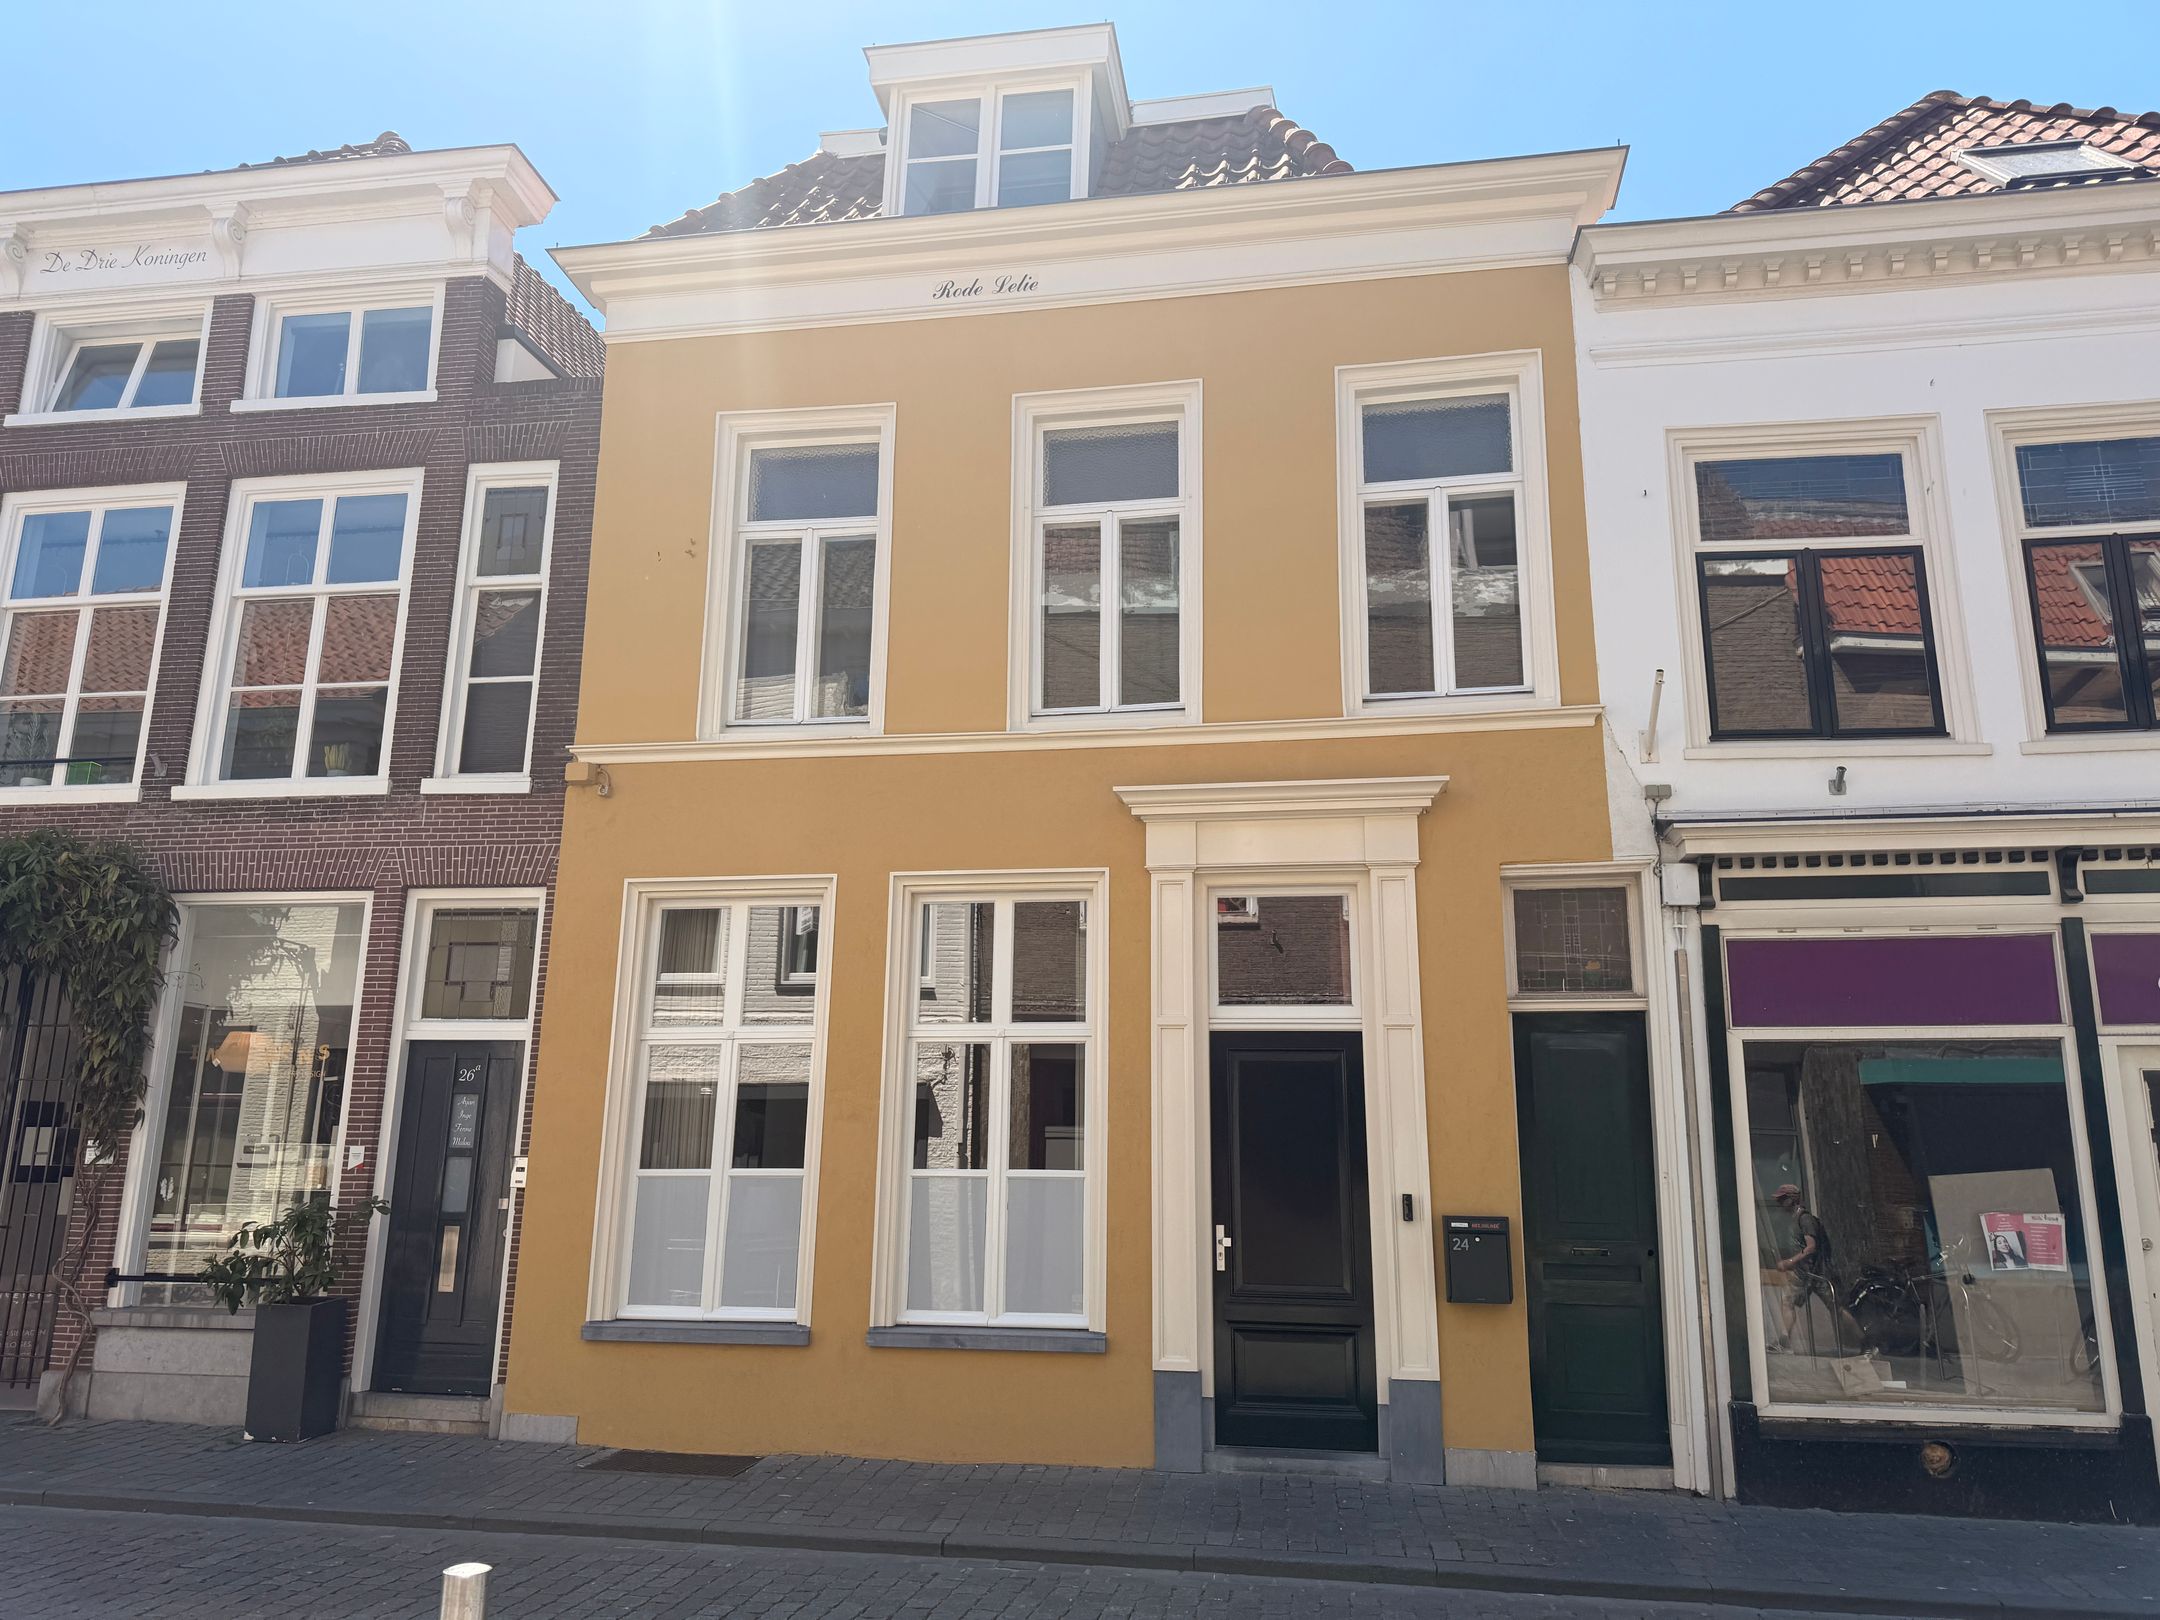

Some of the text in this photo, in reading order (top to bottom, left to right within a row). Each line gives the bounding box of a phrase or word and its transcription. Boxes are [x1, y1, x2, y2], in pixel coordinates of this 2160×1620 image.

[40, 244, 207, 273] De Drie Koningen
[932, 273, 1039, 300] Rode Lelie
[1452, 1237, 1470, 1251] 24
